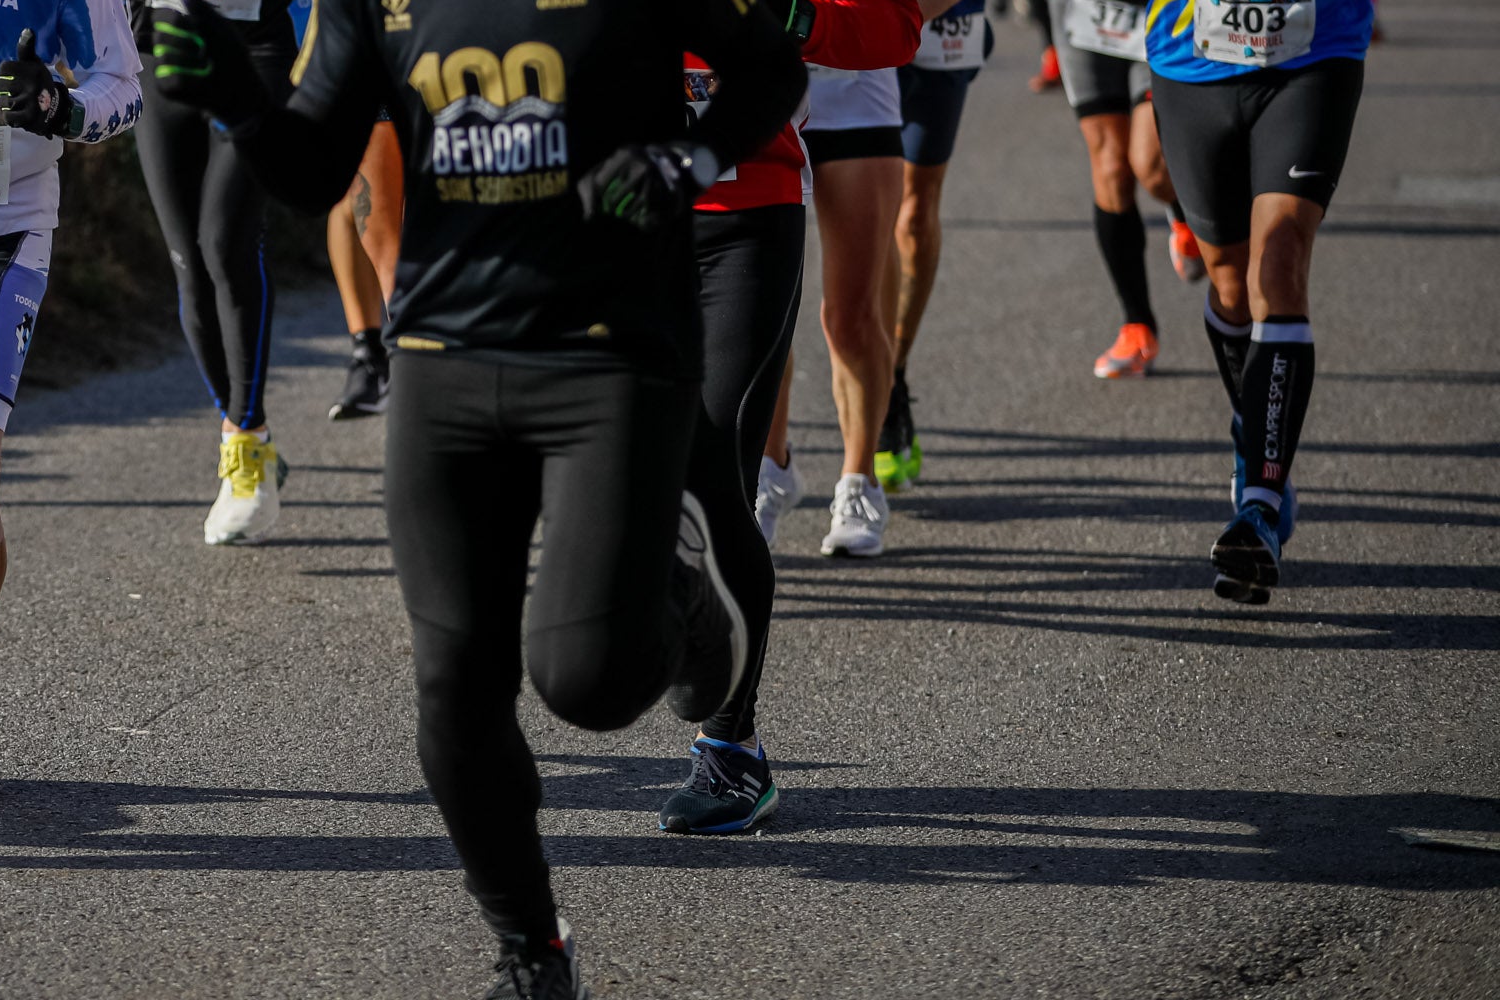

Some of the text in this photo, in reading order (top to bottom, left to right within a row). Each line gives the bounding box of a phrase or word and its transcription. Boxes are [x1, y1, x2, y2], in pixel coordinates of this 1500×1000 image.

[1222, 6, 1286, 34] 403
[1228, 33, 1284, 48] JOSE MIGUEL
[408, 41, 566, 116] 100
[433, 121, 568, 174] BEHOBIA
